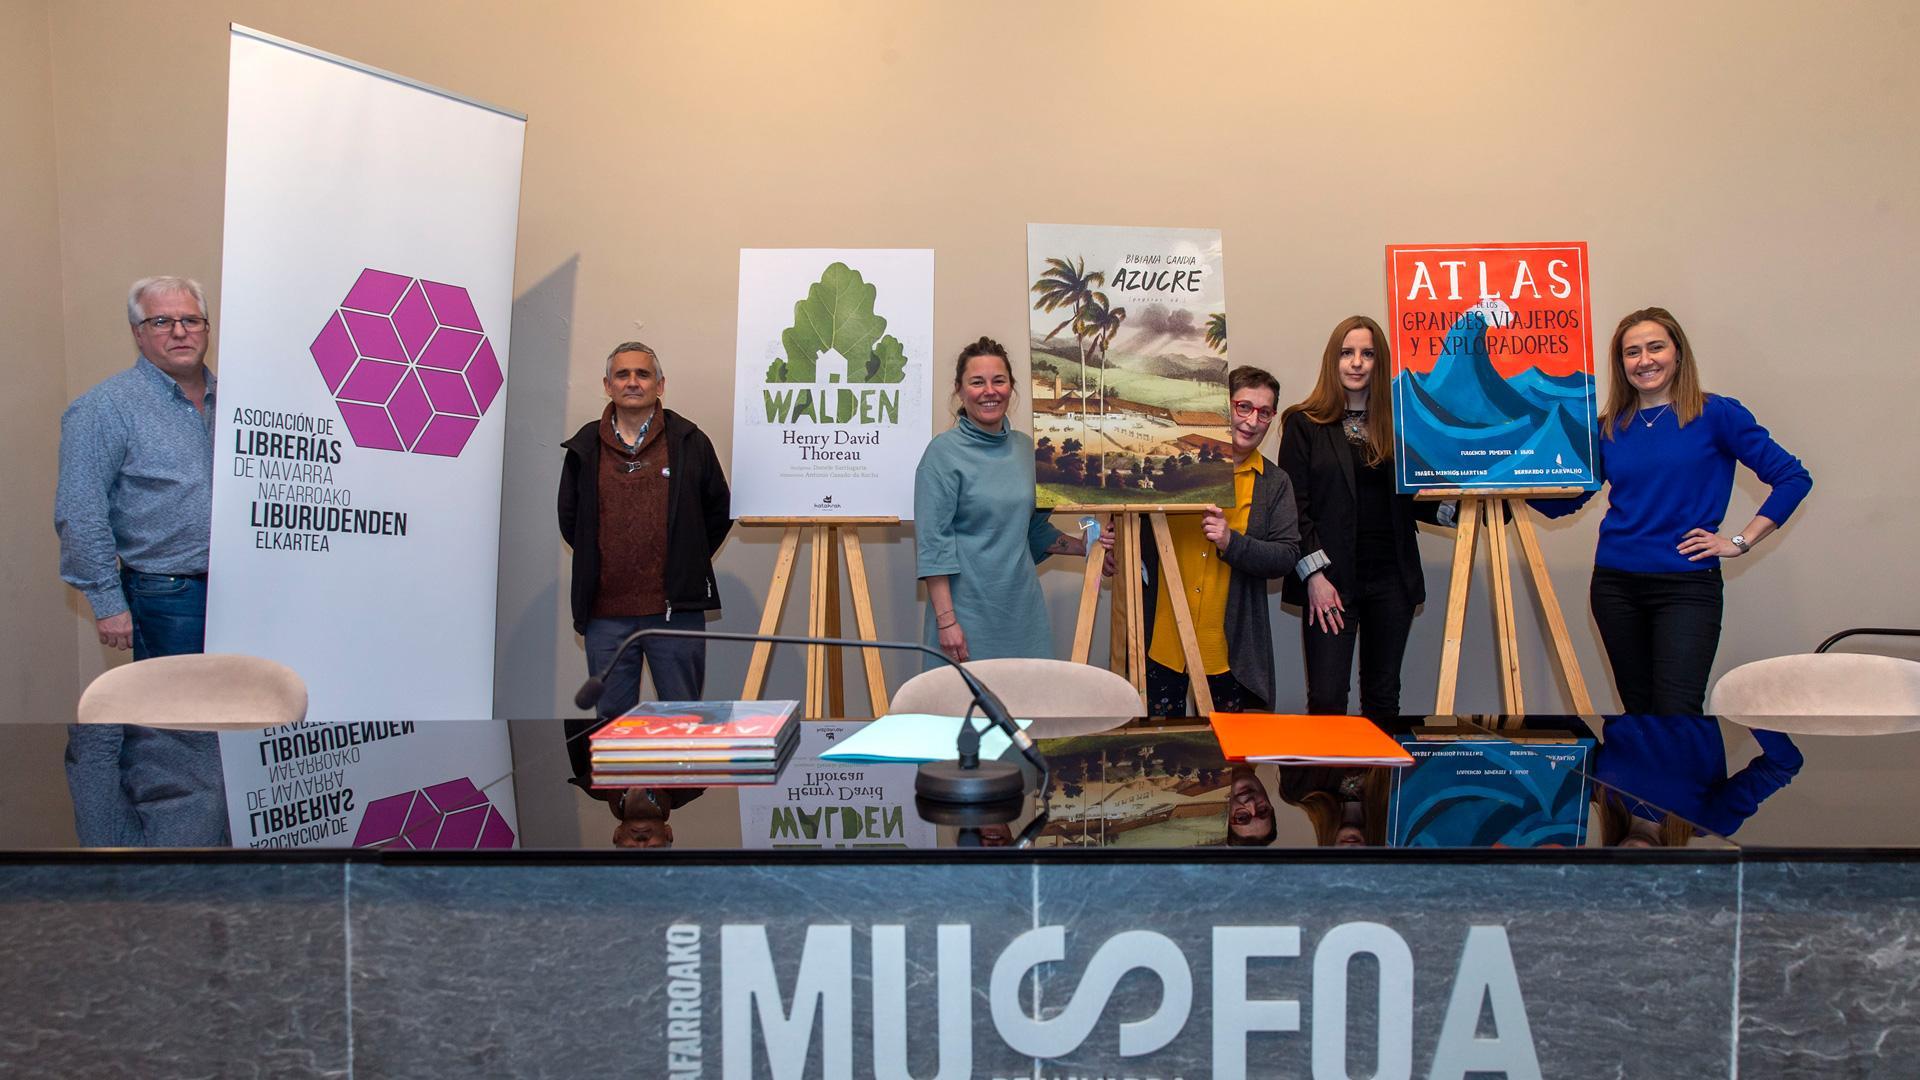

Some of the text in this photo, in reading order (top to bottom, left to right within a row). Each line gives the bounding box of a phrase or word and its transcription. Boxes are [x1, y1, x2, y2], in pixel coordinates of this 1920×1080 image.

[1126, 254, 1196, 266] BIBIANA CANDIA
[1111, 267, 1202, 293] AZUCRE
[1406, 259, 1571, 300] ATLAS
[1402, 309, 1579, 331] GRANDES VIAJEROS
[1429, 334, 1569, 356] EXPLORADORES
[763, 388, 899, 424] WALDEN
[233, 407, 334, 436] ASOCIACIÓN DE
[235, 428, 342, 464] LIBRERÍAS
[782, 430, 880, 450] Henry David
[799, 445, 861, 461] Thoreau
[234, 457, 334, 485] DE NAVARRA
[258, 482, 351, 507] NAFARROAKO
[251, 501, 407, 536] LIBURUDENDEN
[255, 531, 329, 552] ELKARTEA
